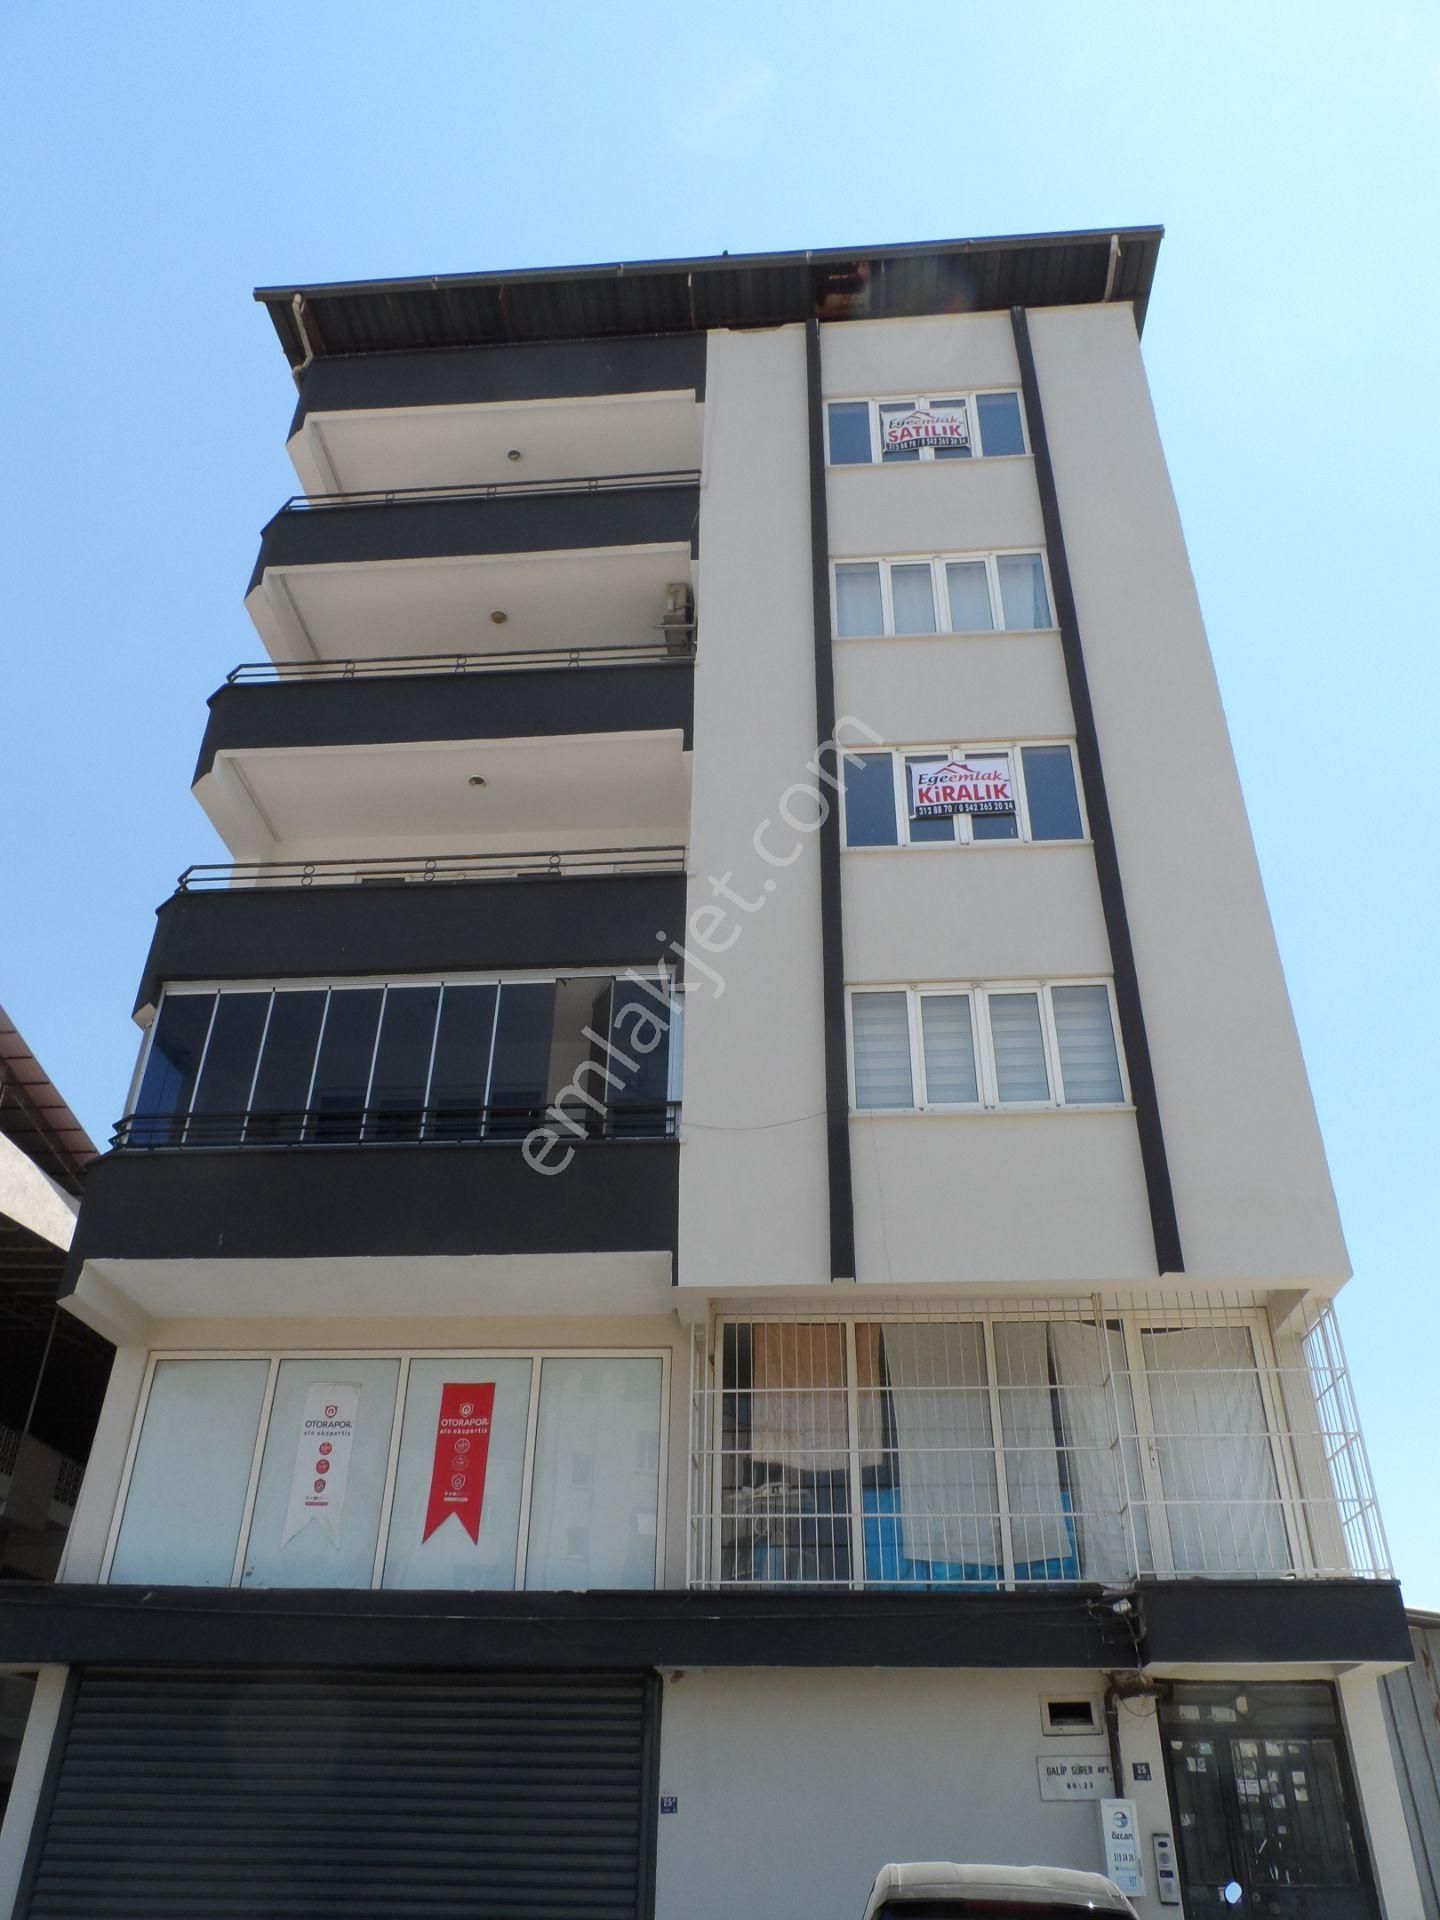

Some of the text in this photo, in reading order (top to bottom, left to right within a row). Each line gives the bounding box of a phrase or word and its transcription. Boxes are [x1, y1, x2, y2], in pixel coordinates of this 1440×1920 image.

[888, 424, 962, 443] SATILIK
[918, 770, 1002, 786] Egeemlak
[919, 807, 931, 816] 312
[933, 806, 942, 814] 88
[944, 805, 953, 813] 70
[965, 804, 978, 812] 542
[994, 802, 1003, 811] 20
[1004, 802, 1013, 810] 24
[305, 1420, 352, 1429] OTORAPOR
[441, 1418, 489, 1427] OTORAPOR
[1112, 1831, 1133, 1840] özcan
